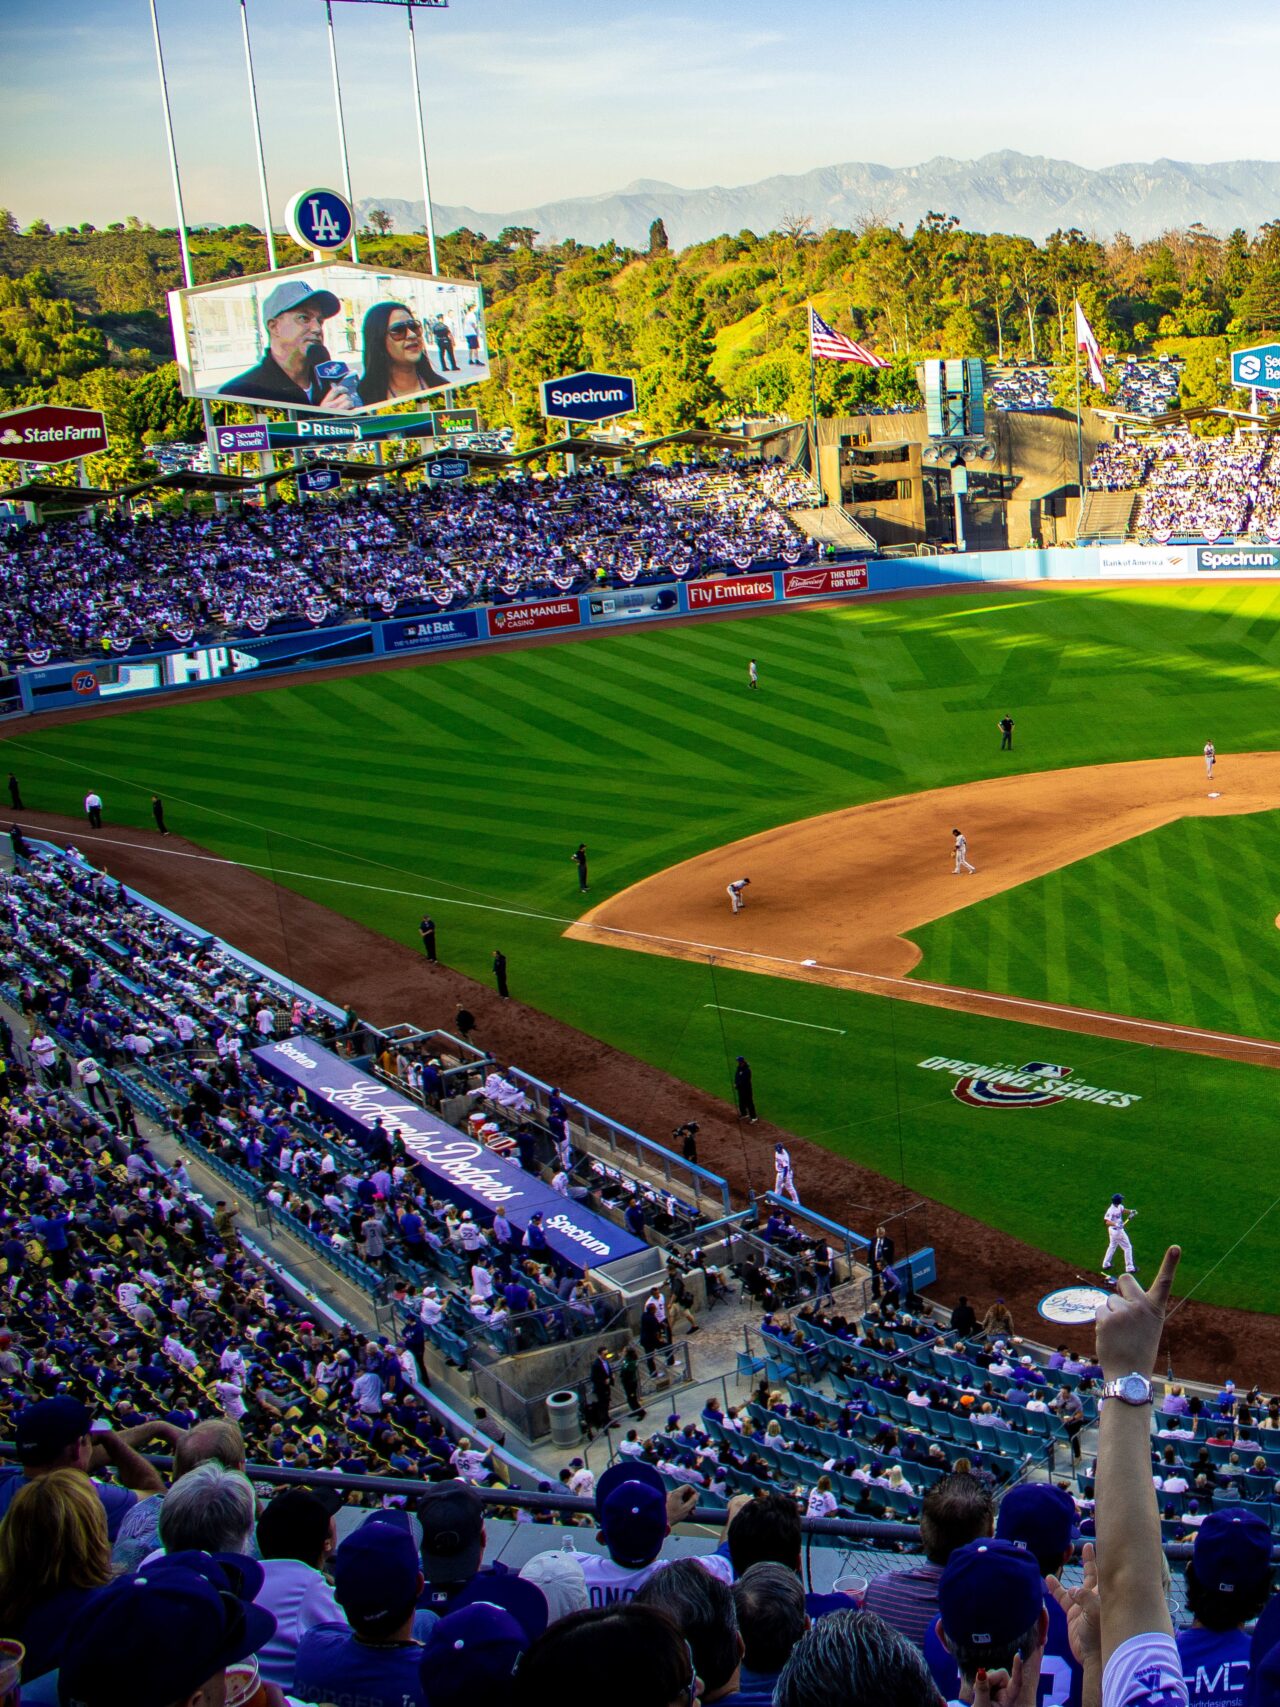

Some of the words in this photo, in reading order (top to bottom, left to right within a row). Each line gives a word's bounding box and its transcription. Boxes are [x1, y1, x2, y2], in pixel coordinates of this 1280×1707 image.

[308, 199, 340, 240] LA
[551, 389, 623, 408] Spectrum
[236, 430, 264, 439] Security
[237, 438, 262, 447] Benefit
[1103, 559, 1121, 567] Bank
[1132, 559, 1164, 567] America
[1201, 551, 1274, 570] Spectrum
[791, 576, 825, 588] Budweiser
[831, 571, 845, 579] THIS
[846, 568, 866, 577] BUD'S
[831, 579, 844, 587] FOR
[690, 588, 713, 603] Fly
[714, 581, 772, 598] Emirates
[506, 608, 528, 621] SAN
[530, 603, 573, 618] MANUEL
[417, 624, 432, 636] At
[433, 621, 455, 634] Bat
[507, 618, 534, 628] CASINO
[78, 674, 94, 690] 76
[274, 1042, 318, 1069] Spectrum
[917, 1056, 1041, 1088] OPENING
[1033, 1078, 1143, 1108] SERIES
[320, 1081, 388, 1103] Los
[417, 1141, 524, 1202] Dodgers
[546, 1213, 612, 1256] Spectrum
